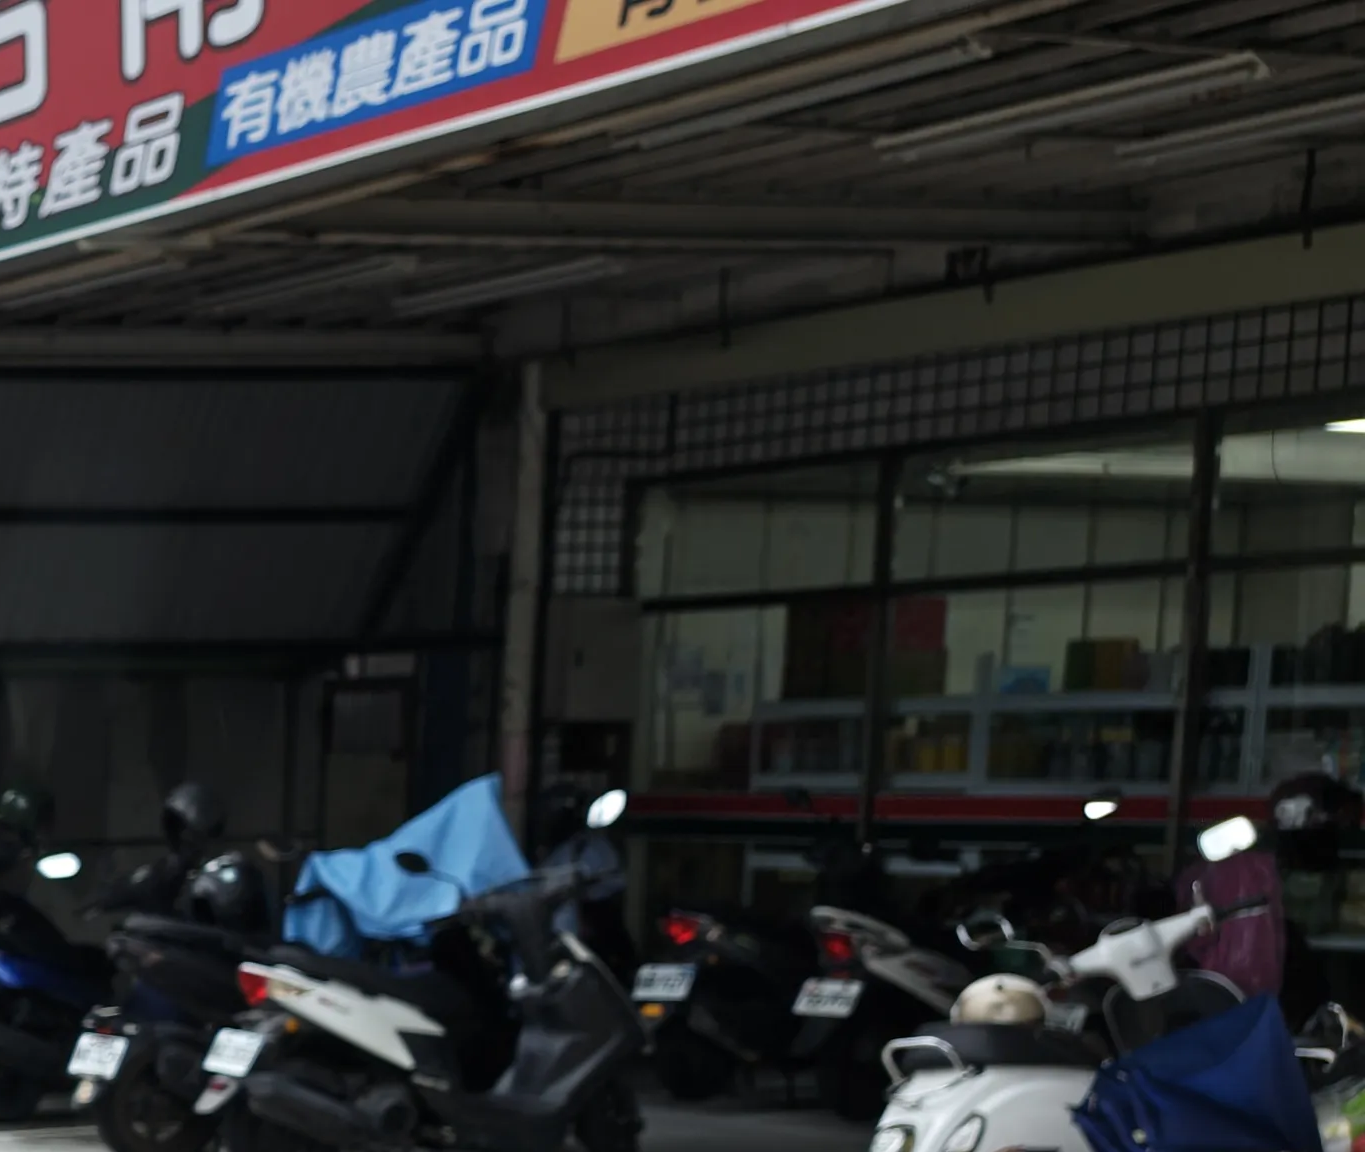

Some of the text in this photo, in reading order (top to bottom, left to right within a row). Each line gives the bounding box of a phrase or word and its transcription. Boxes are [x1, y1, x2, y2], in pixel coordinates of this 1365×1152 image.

[221, 0, 528, 150] 有機農產品
